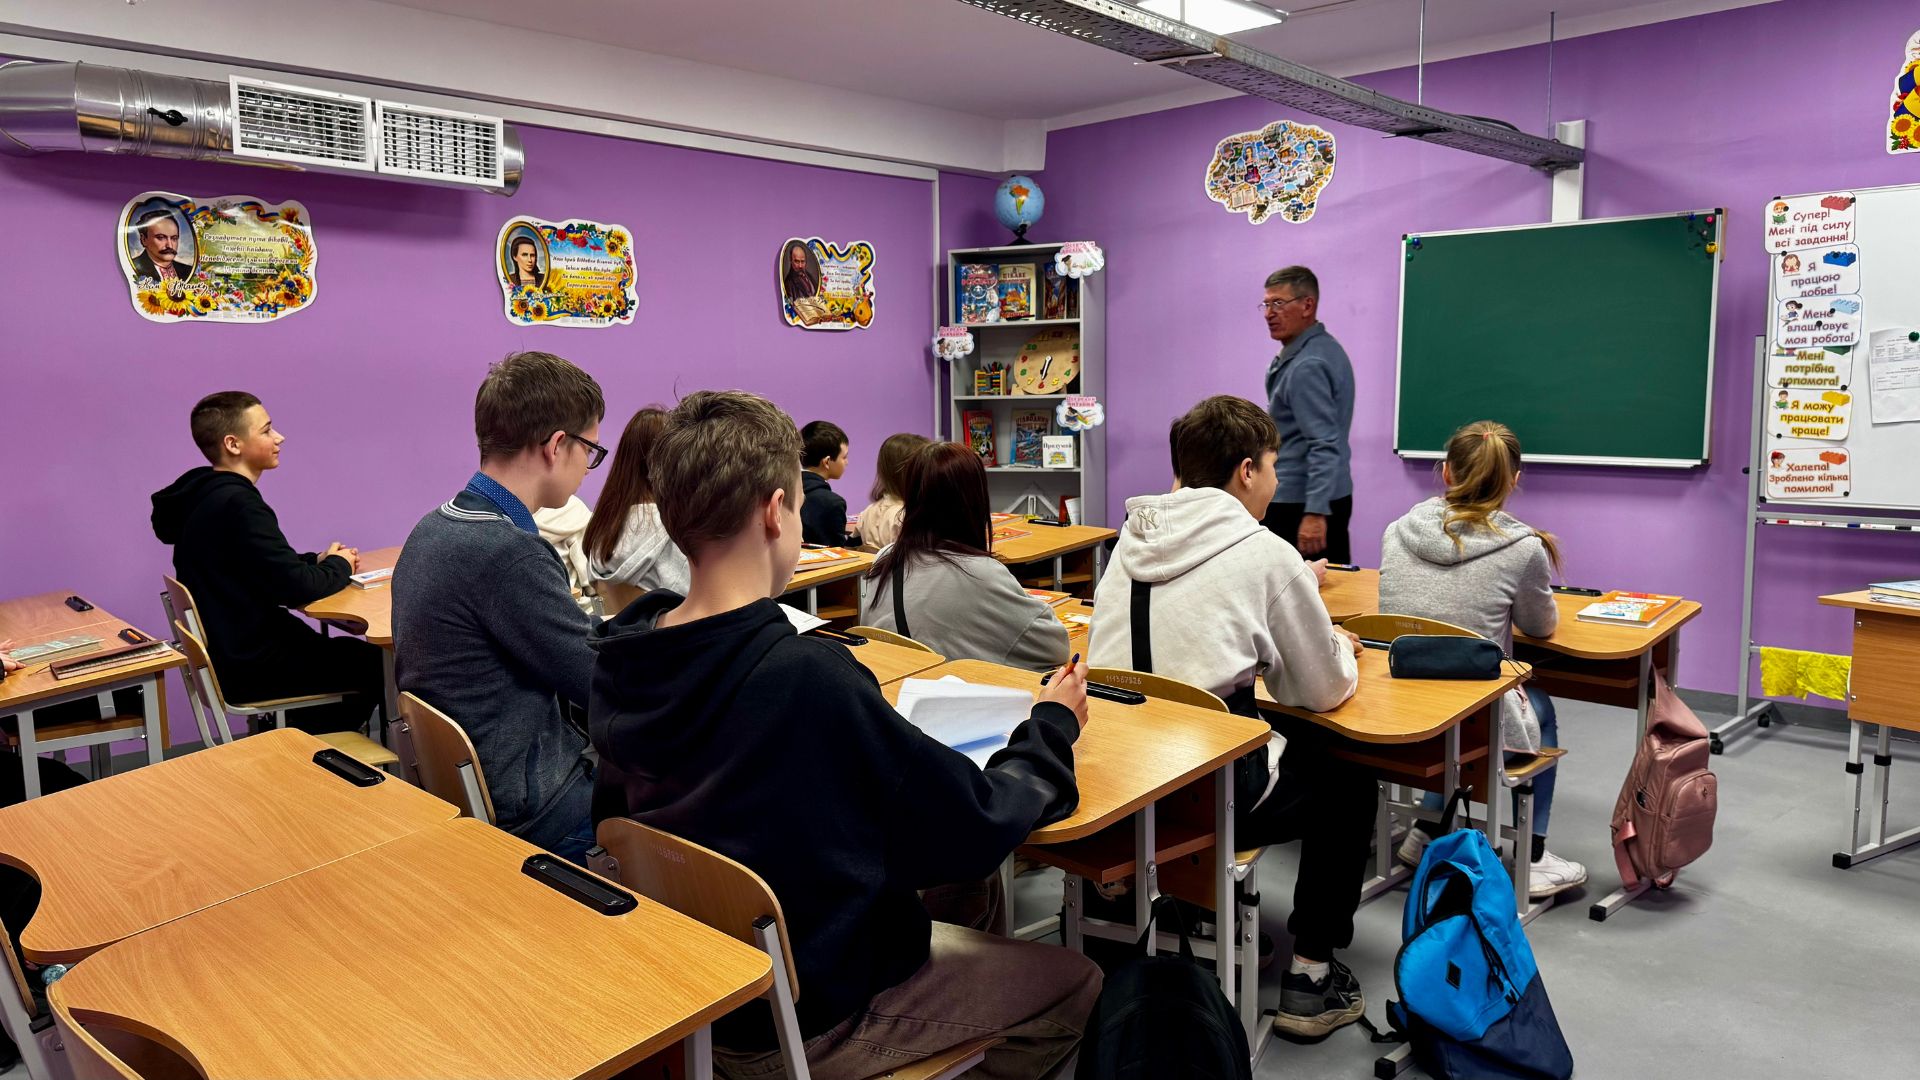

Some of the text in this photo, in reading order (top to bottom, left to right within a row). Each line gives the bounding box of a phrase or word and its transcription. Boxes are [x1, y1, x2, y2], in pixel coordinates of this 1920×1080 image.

[1793, 208, 1830, 221] Супер!
[1769, 221, 1851, 236] Мені під силу
[1775, 232, 1849, 248] всі завдання!
[1808, 262, 1816, 271] Я
[1791, 274, 1840, 288] працюю
[1800, 284, 1837, 297] добре!
[1803, 309, 1834, 318] Мене
[1784, 333, 1854, 345] моя робота!
[1796, 351, 1825, 360] Мені
[1785, 363, 1835, 375] потрібна
[1778, 376, 1839, 386] допомога!
[1791, 400, 1834, 413] Я можу
[1780, 414, 1844, 426] працювати
[1791, 427, 1830, 438] краще!
[1786, 462, 1830, 472] Халепа!
[1769, 473, 1848, 484] Зроблено кілька
[1784, 483, 1834, 493] помилок!
